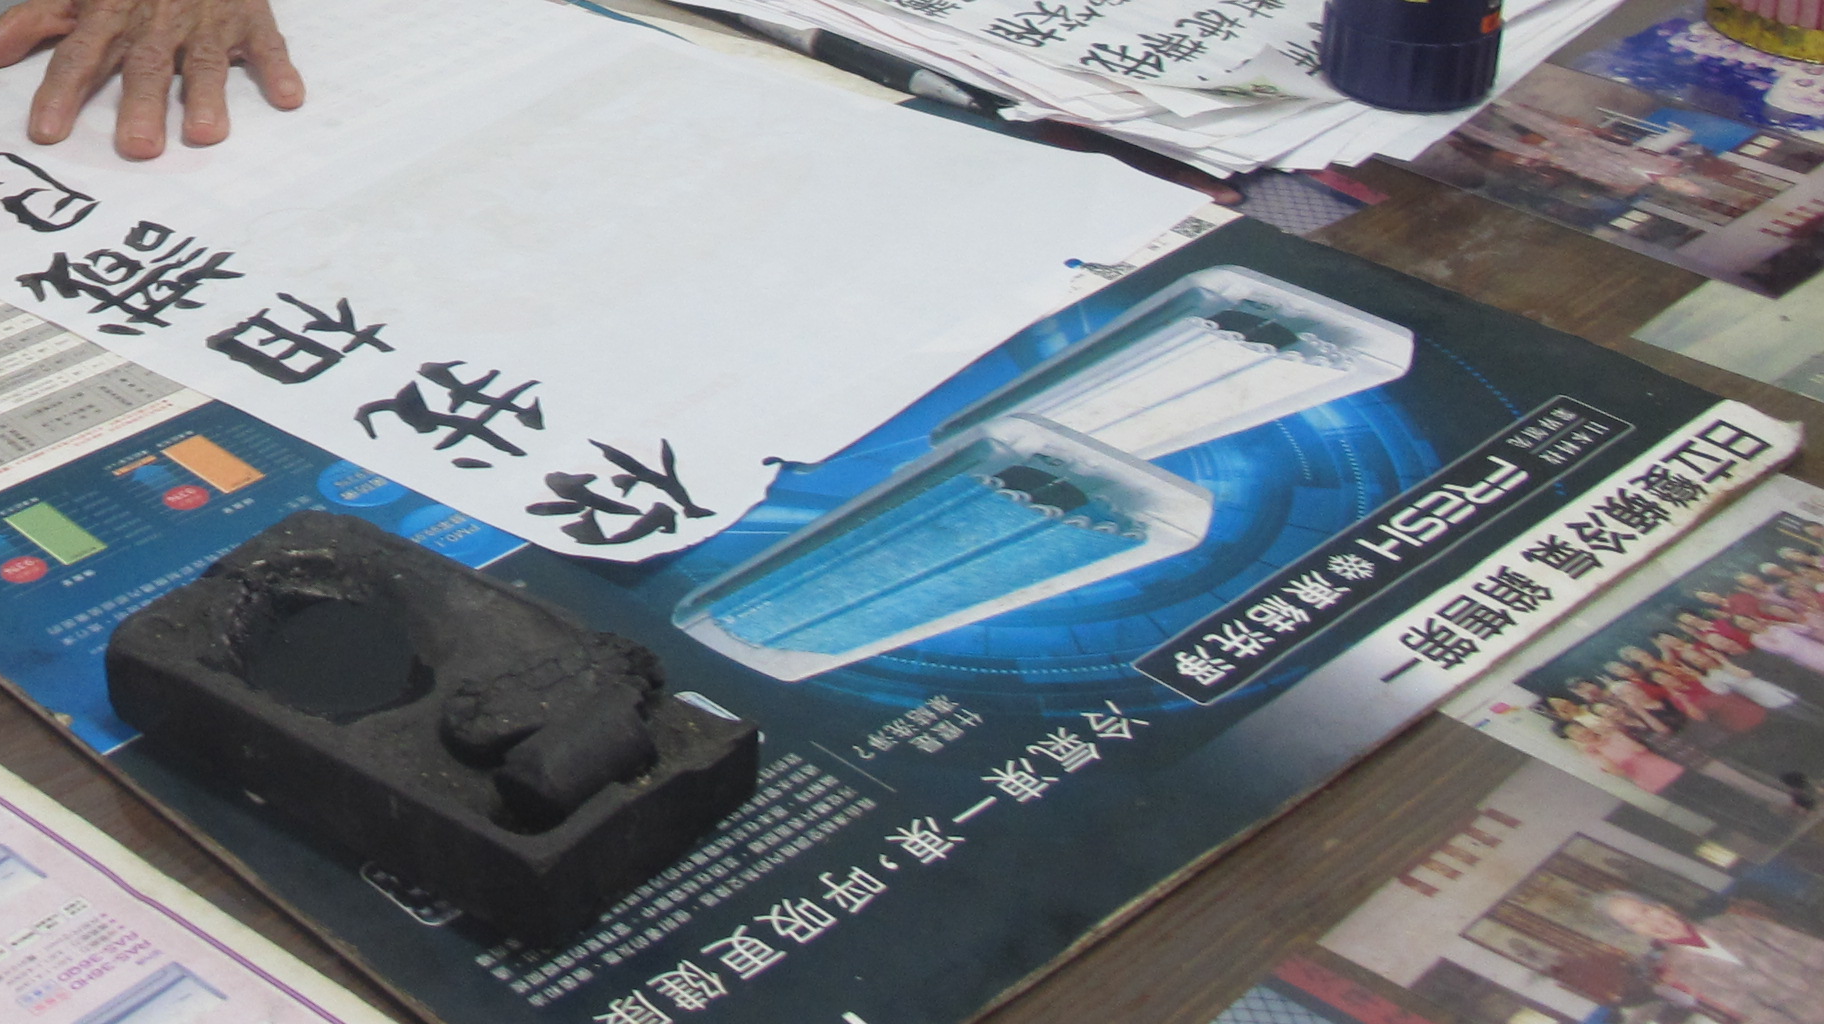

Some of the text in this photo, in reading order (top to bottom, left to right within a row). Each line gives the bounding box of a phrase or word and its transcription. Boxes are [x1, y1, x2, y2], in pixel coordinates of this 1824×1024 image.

[1360, 454, 1531, 562] FRESH
[1521, 417, 1774, 581] 日立變頻冷氣
[1174, 568, 1352, 686] 凍結洗淨
[1379, 565, 1555, 684] 銷售第一
